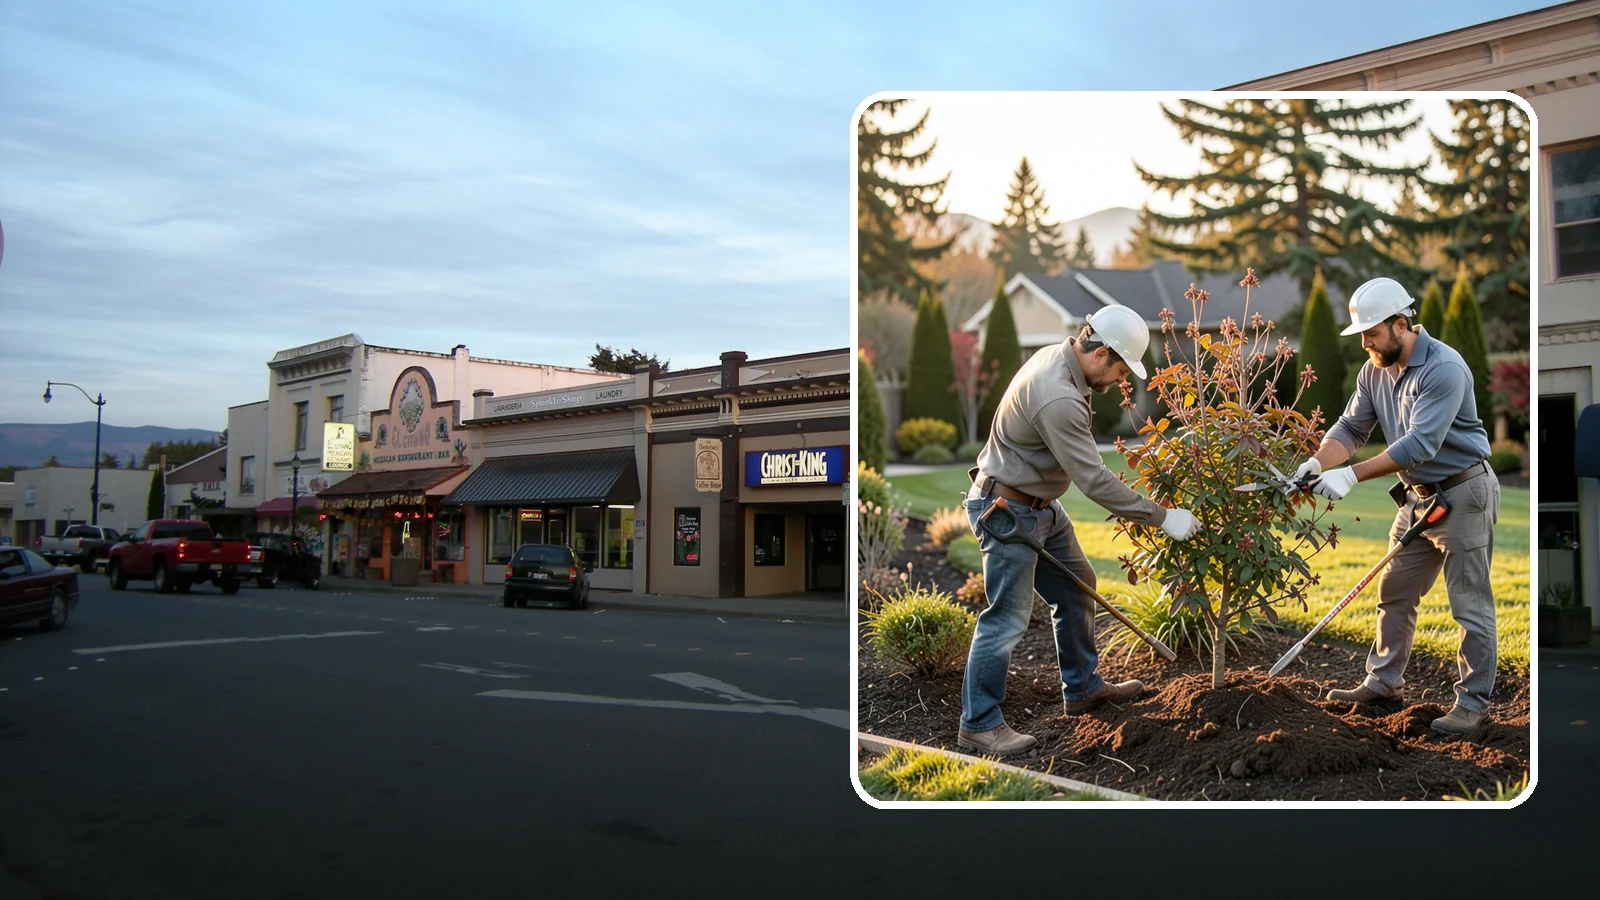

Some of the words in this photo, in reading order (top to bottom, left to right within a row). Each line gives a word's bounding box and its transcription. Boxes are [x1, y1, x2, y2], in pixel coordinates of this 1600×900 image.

[562, 394, 582, 404] Shop
[595, 388, 624, 400] LAUNDRY
[493, 402, 523, 413] LAVANDERIA
[373, 455, 396, 464] MEXICAN
[397, 451, 433, 462] RESTAURANT
[437, 450, 450, 459] BAR
[761, 452, 797, 478] CHRIST
[799, 450, 827, 477] KING
